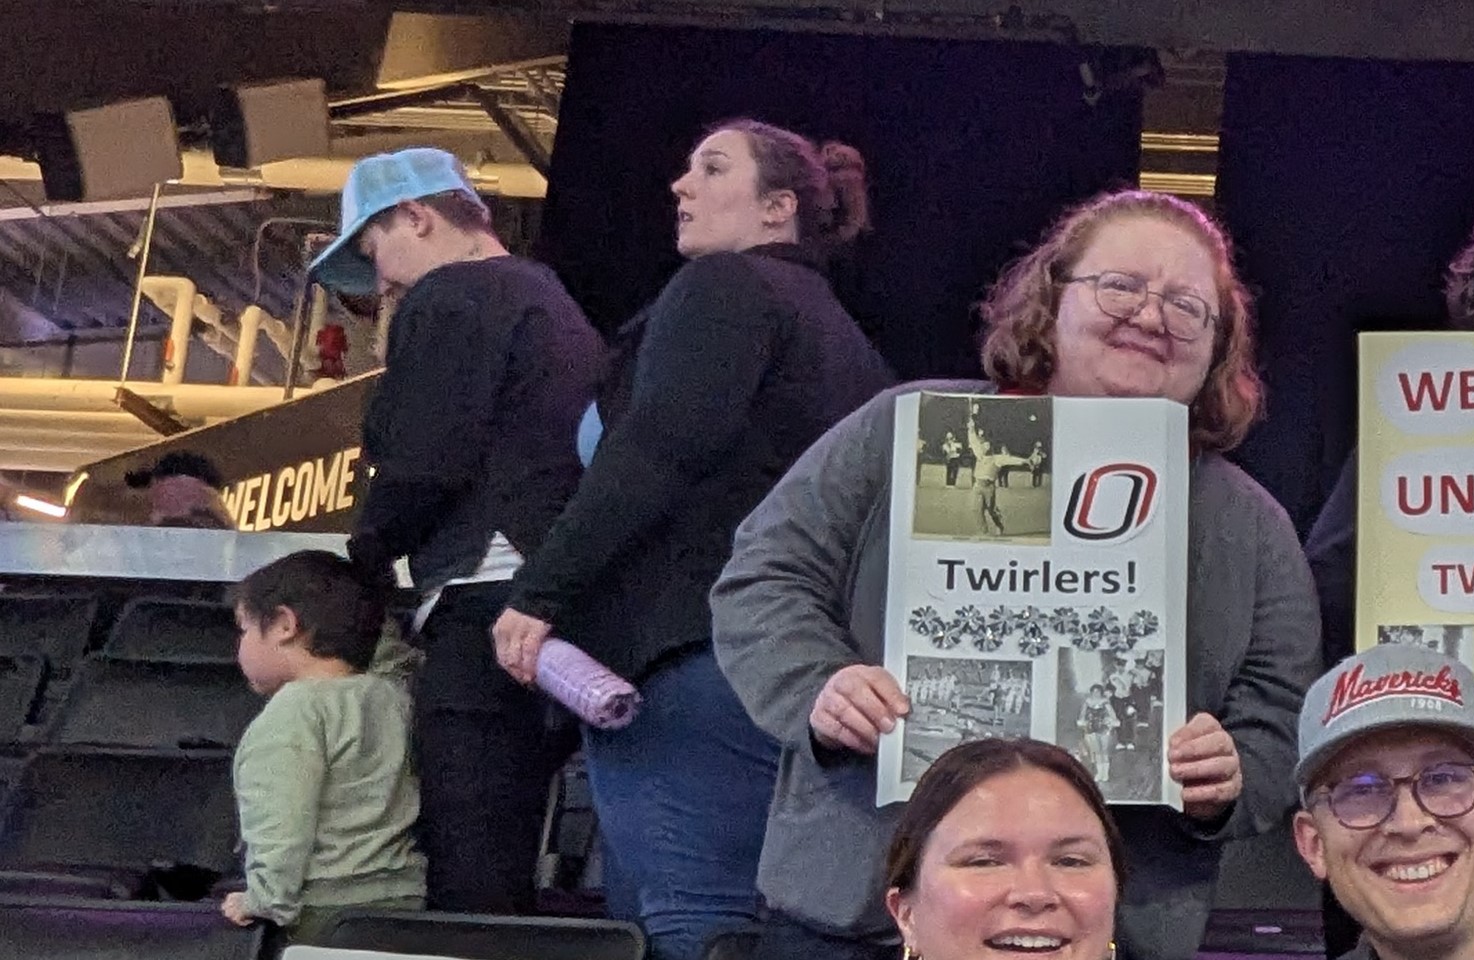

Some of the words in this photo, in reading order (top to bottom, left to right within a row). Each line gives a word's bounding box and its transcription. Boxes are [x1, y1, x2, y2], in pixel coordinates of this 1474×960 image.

[222, 446, 362, 532] WELCOME
[937, 559, 1136, 594] Twirlers!
[1323, 663, 1463, 724] Mavericks
